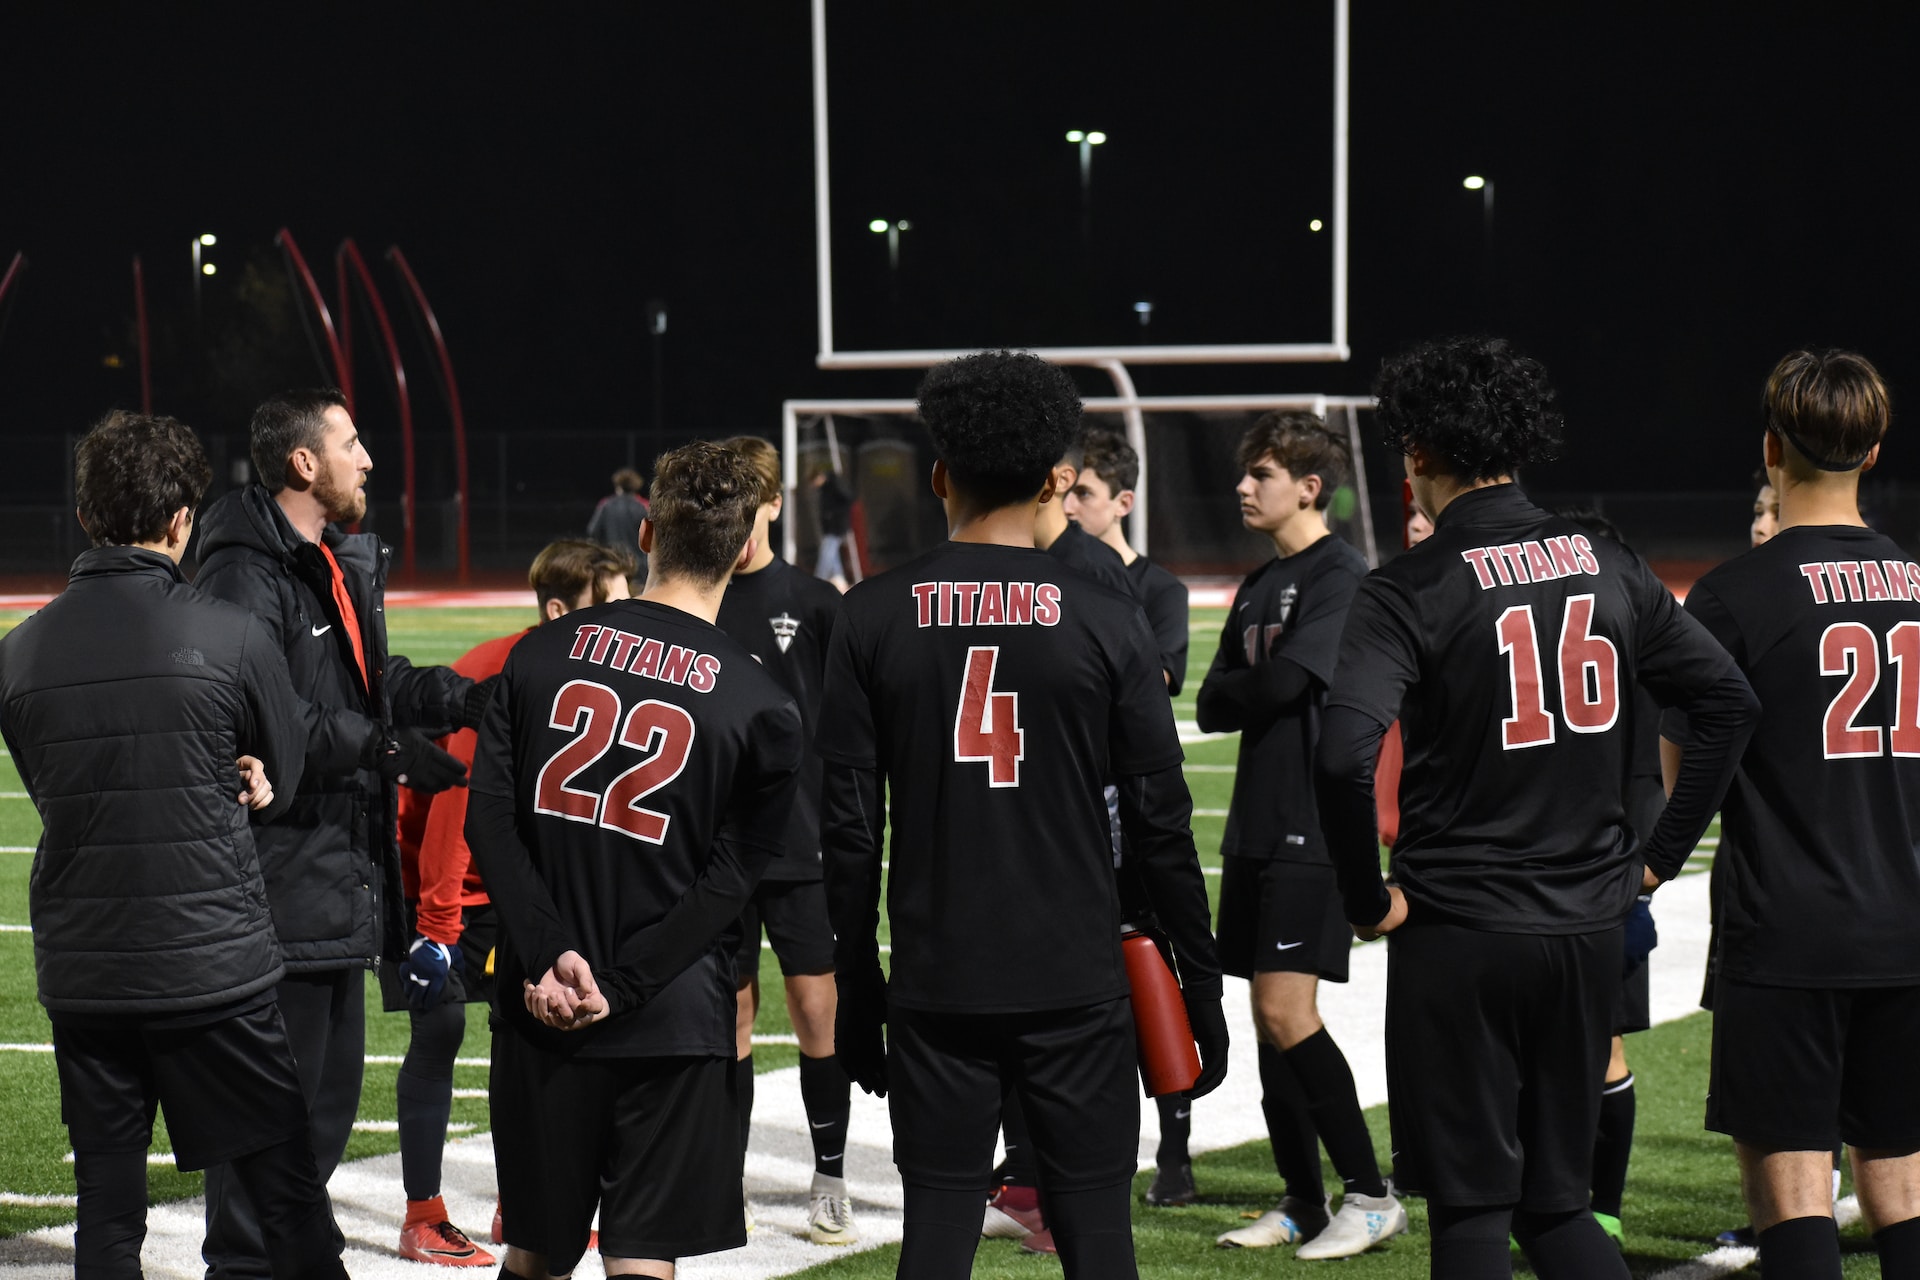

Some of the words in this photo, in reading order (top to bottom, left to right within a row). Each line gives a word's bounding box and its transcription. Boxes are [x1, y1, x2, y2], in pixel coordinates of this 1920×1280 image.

[912, 581, 1062, 628] TITANS
[1461, 534, 1600, 590] TITANS
[1799, 560, 1920, 605] TITANS
[569, 624, 721, 693] TITANS
[1495, 593, 1620, 750] 16
[1819, 621, 1920, 760] 21
[534, 679, 695, 846] 22
[954, 645, 1025, 788] 4
